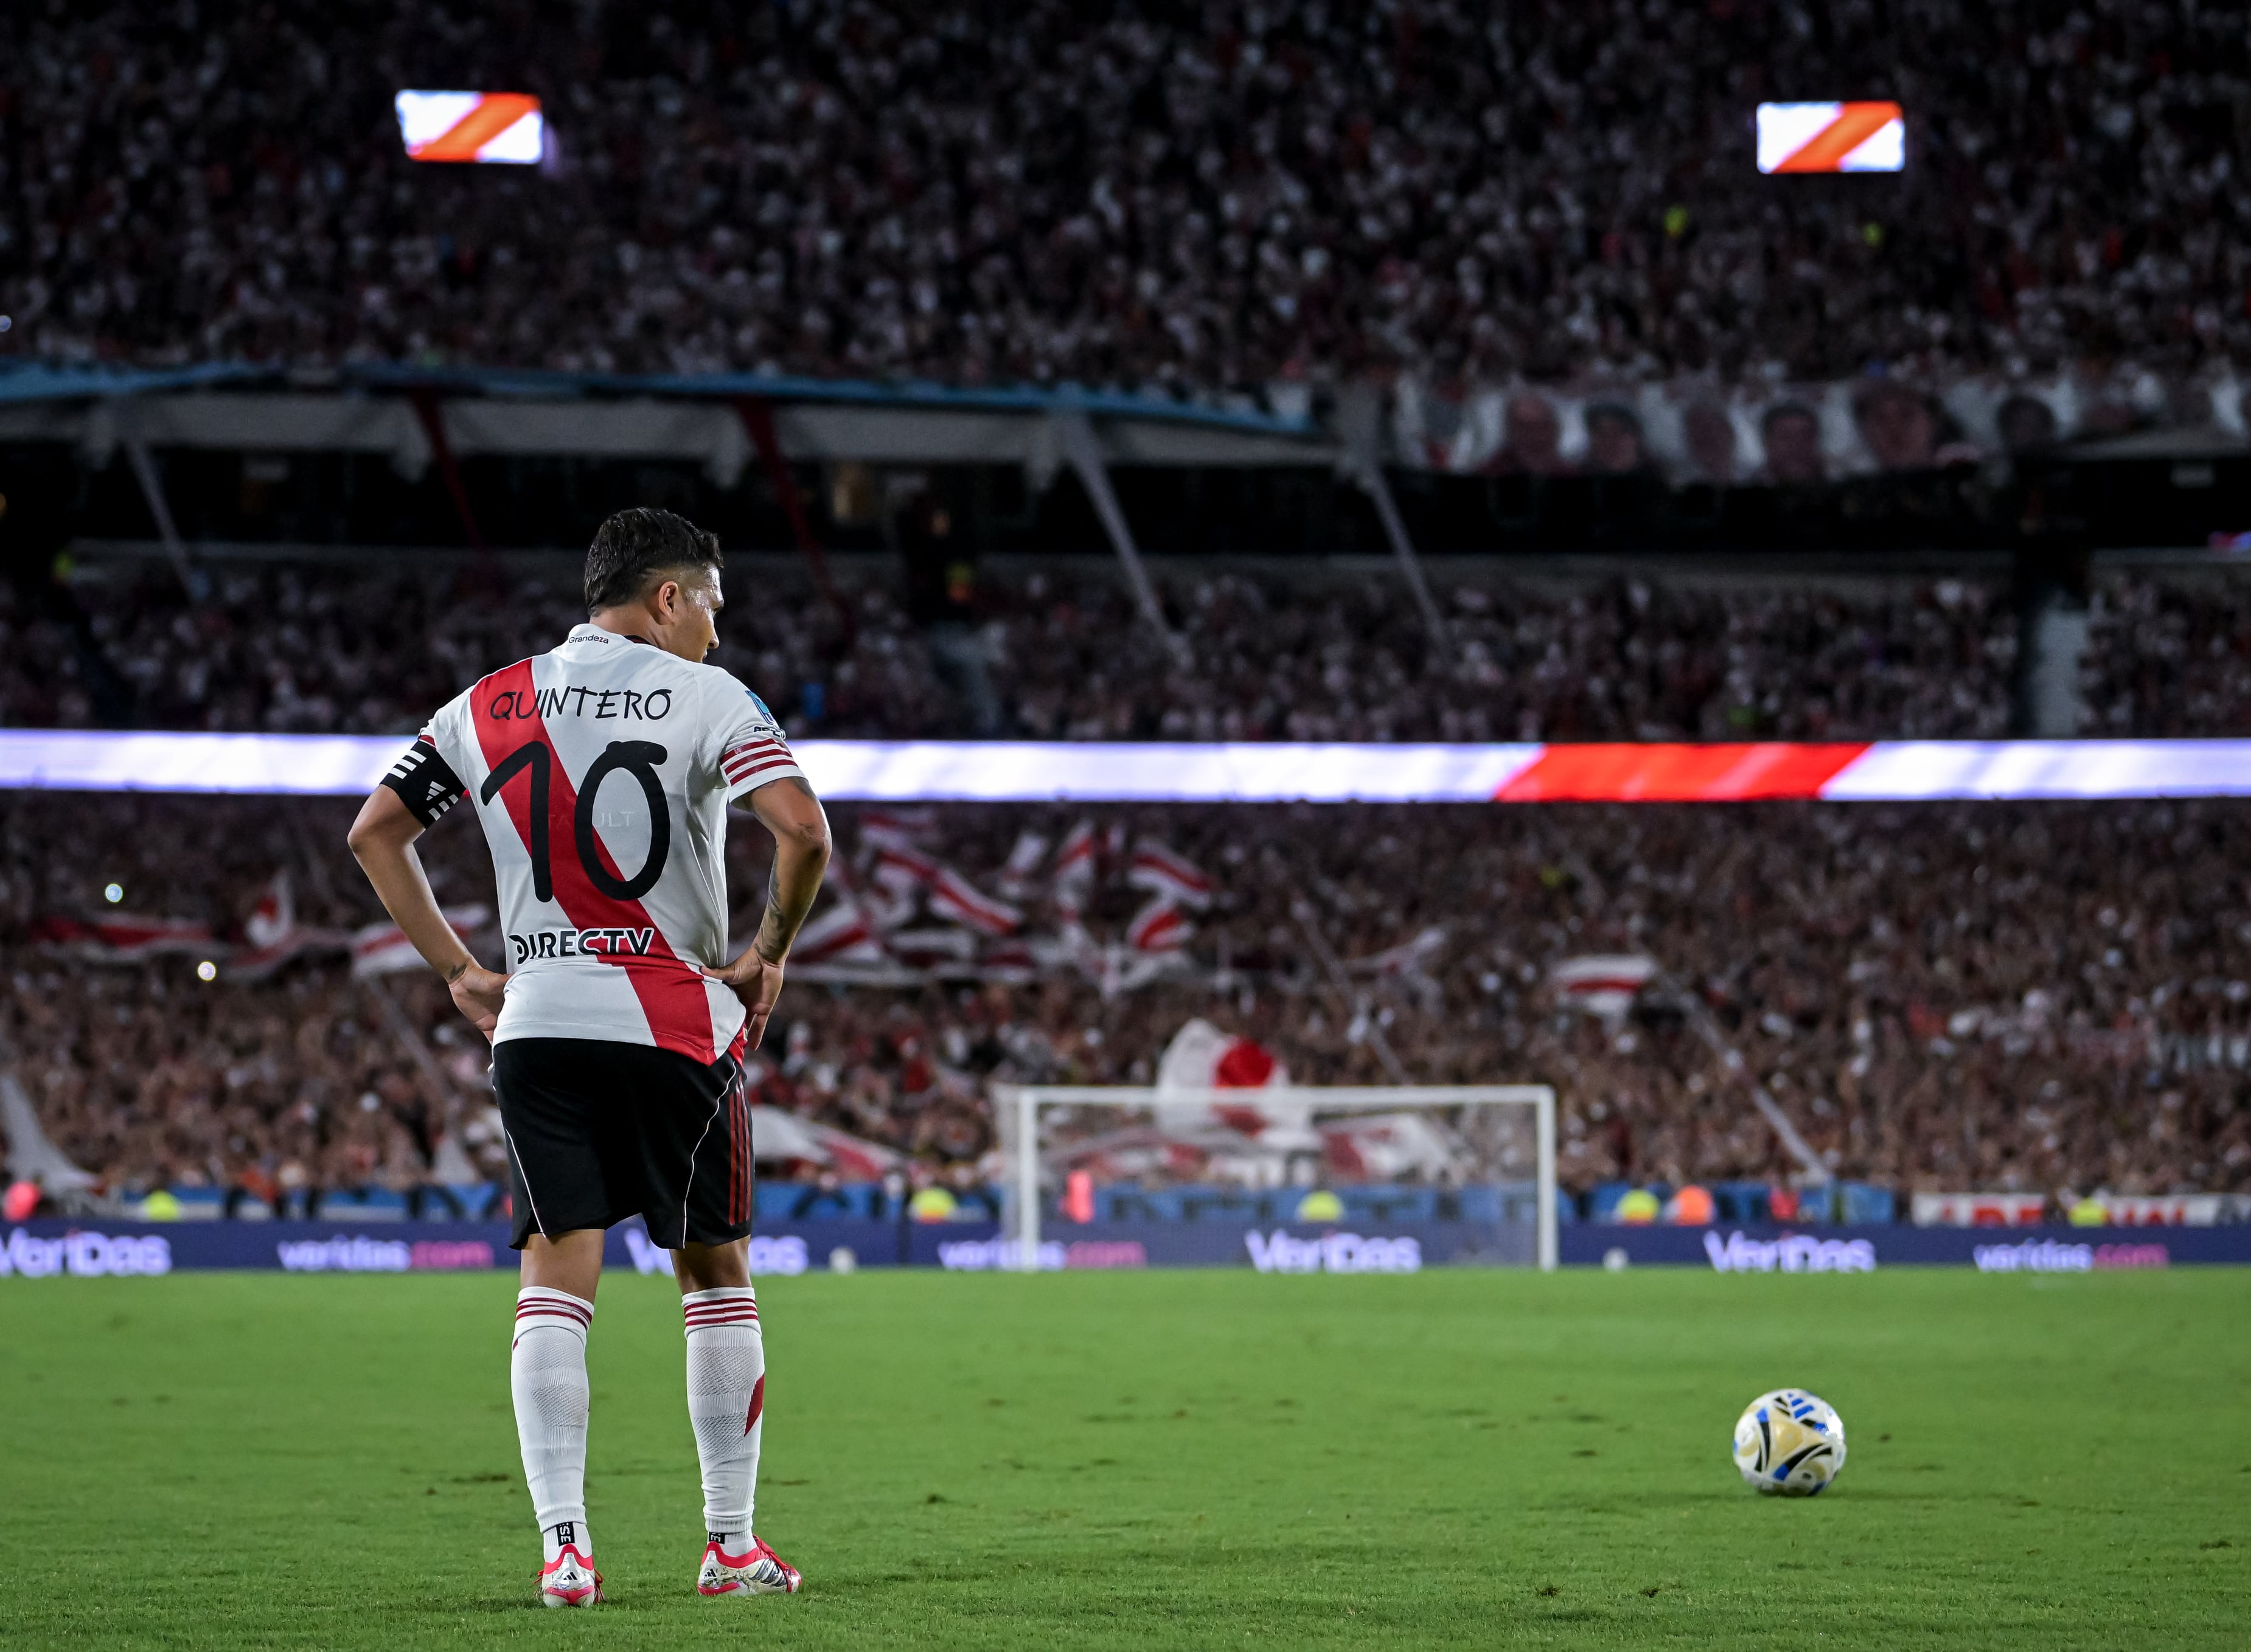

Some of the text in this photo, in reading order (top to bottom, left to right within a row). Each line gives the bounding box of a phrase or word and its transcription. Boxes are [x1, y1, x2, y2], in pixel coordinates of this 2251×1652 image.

[568, 634, 609, 644] Grandeza
[490, 686, 672, 720] QUINTERO
[480, 740, 670, 903] 10
[509, 929, 654, 965] DIRECTV
